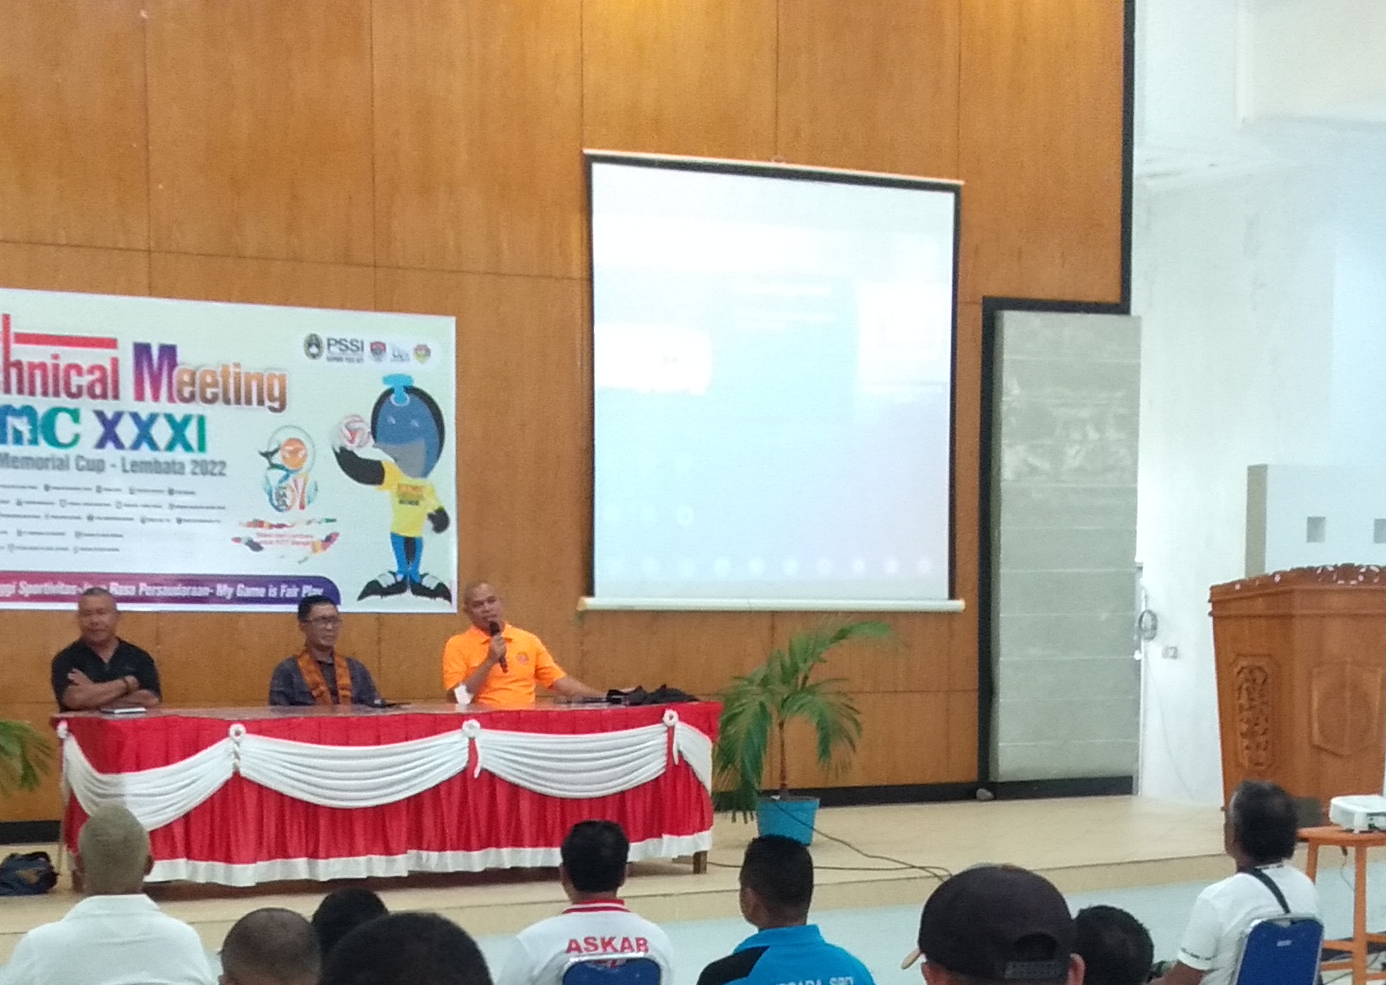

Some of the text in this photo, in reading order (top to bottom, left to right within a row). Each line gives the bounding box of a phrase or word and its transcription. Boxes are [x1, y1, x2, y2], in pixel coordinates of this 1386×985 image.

[327, 338, 364, 353] PSSI
[133, 342, 289, 414] Meeting
[93, 409, 207, 453] XXXI
[75, 455, 105, 473] Cup
[121, 457, 186, 475] Lembata
[190, 460, 227, 477] 2022
[236, 584, 266, 598] Game
[268, 585, 278, 598] is
[280, 585, 300, 598] Fair
[565, 935, 649, 954] ASKAB
